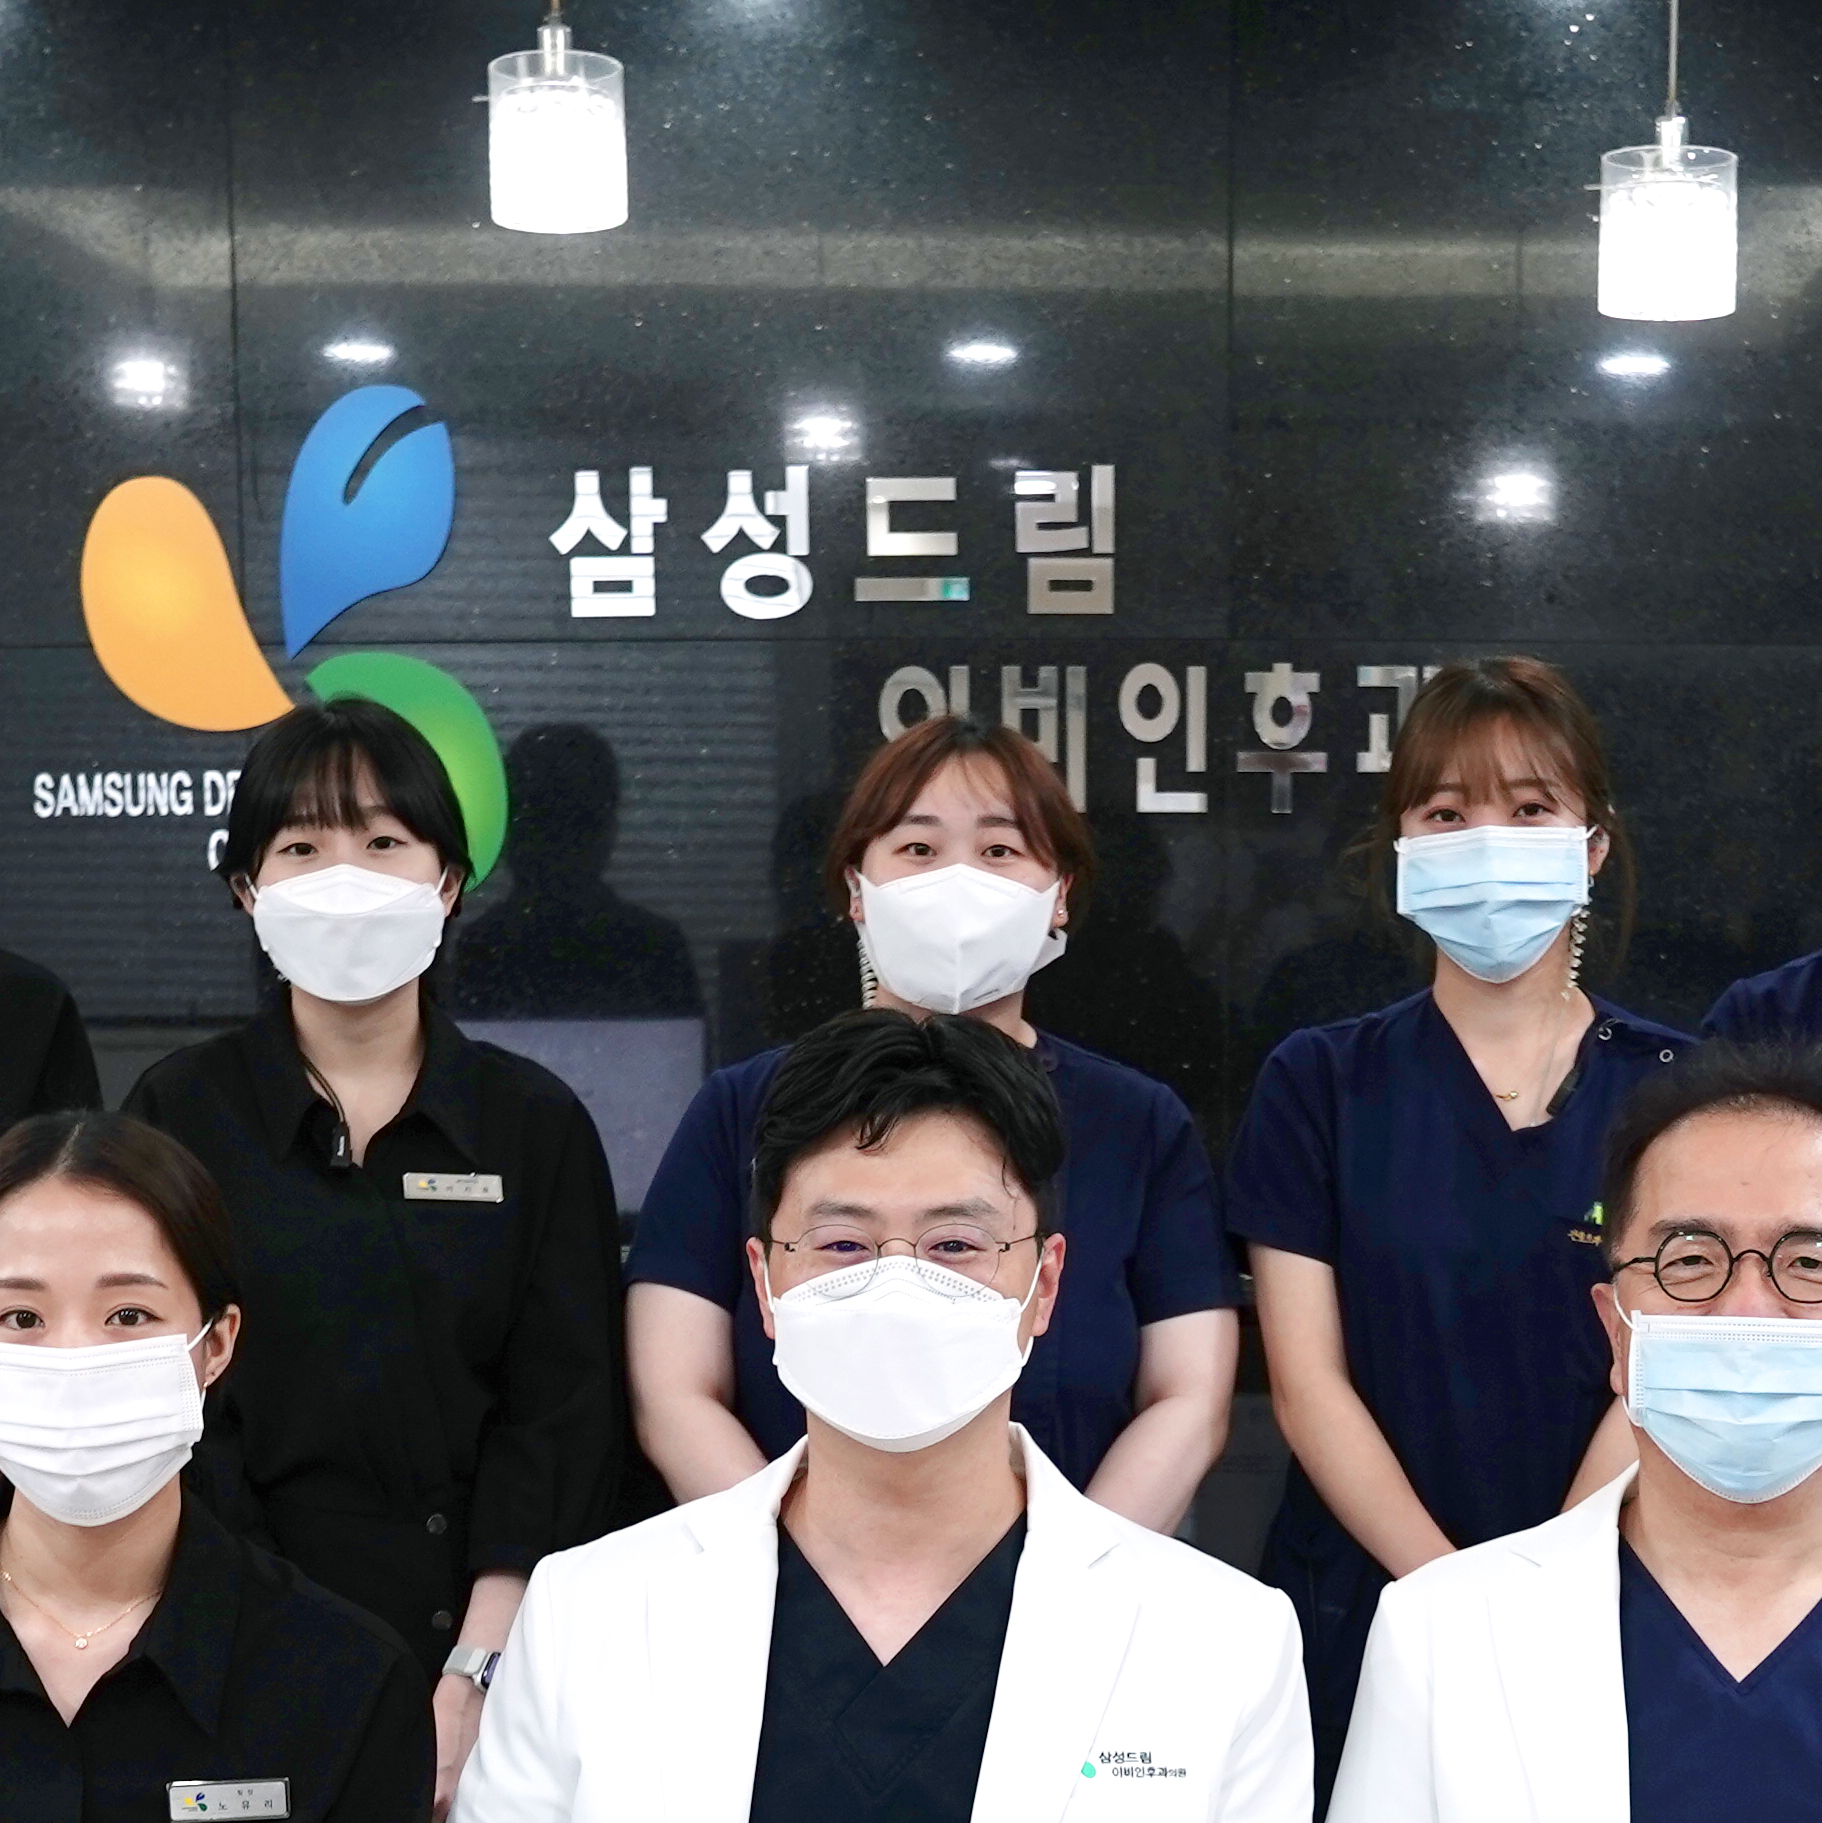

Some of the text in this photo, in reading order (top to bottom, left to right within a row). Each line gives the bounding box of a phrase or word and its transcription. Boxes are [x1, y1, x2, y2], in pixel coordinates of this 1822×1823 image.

[548, 464, 1116, 620] 삼성드림
[33, 770, 195, 819] SAMSUNG
[1098, 1751, 1153, 1765] 삼성드림
[1111, 1766, 1187, 1779] 이비인후과의원
